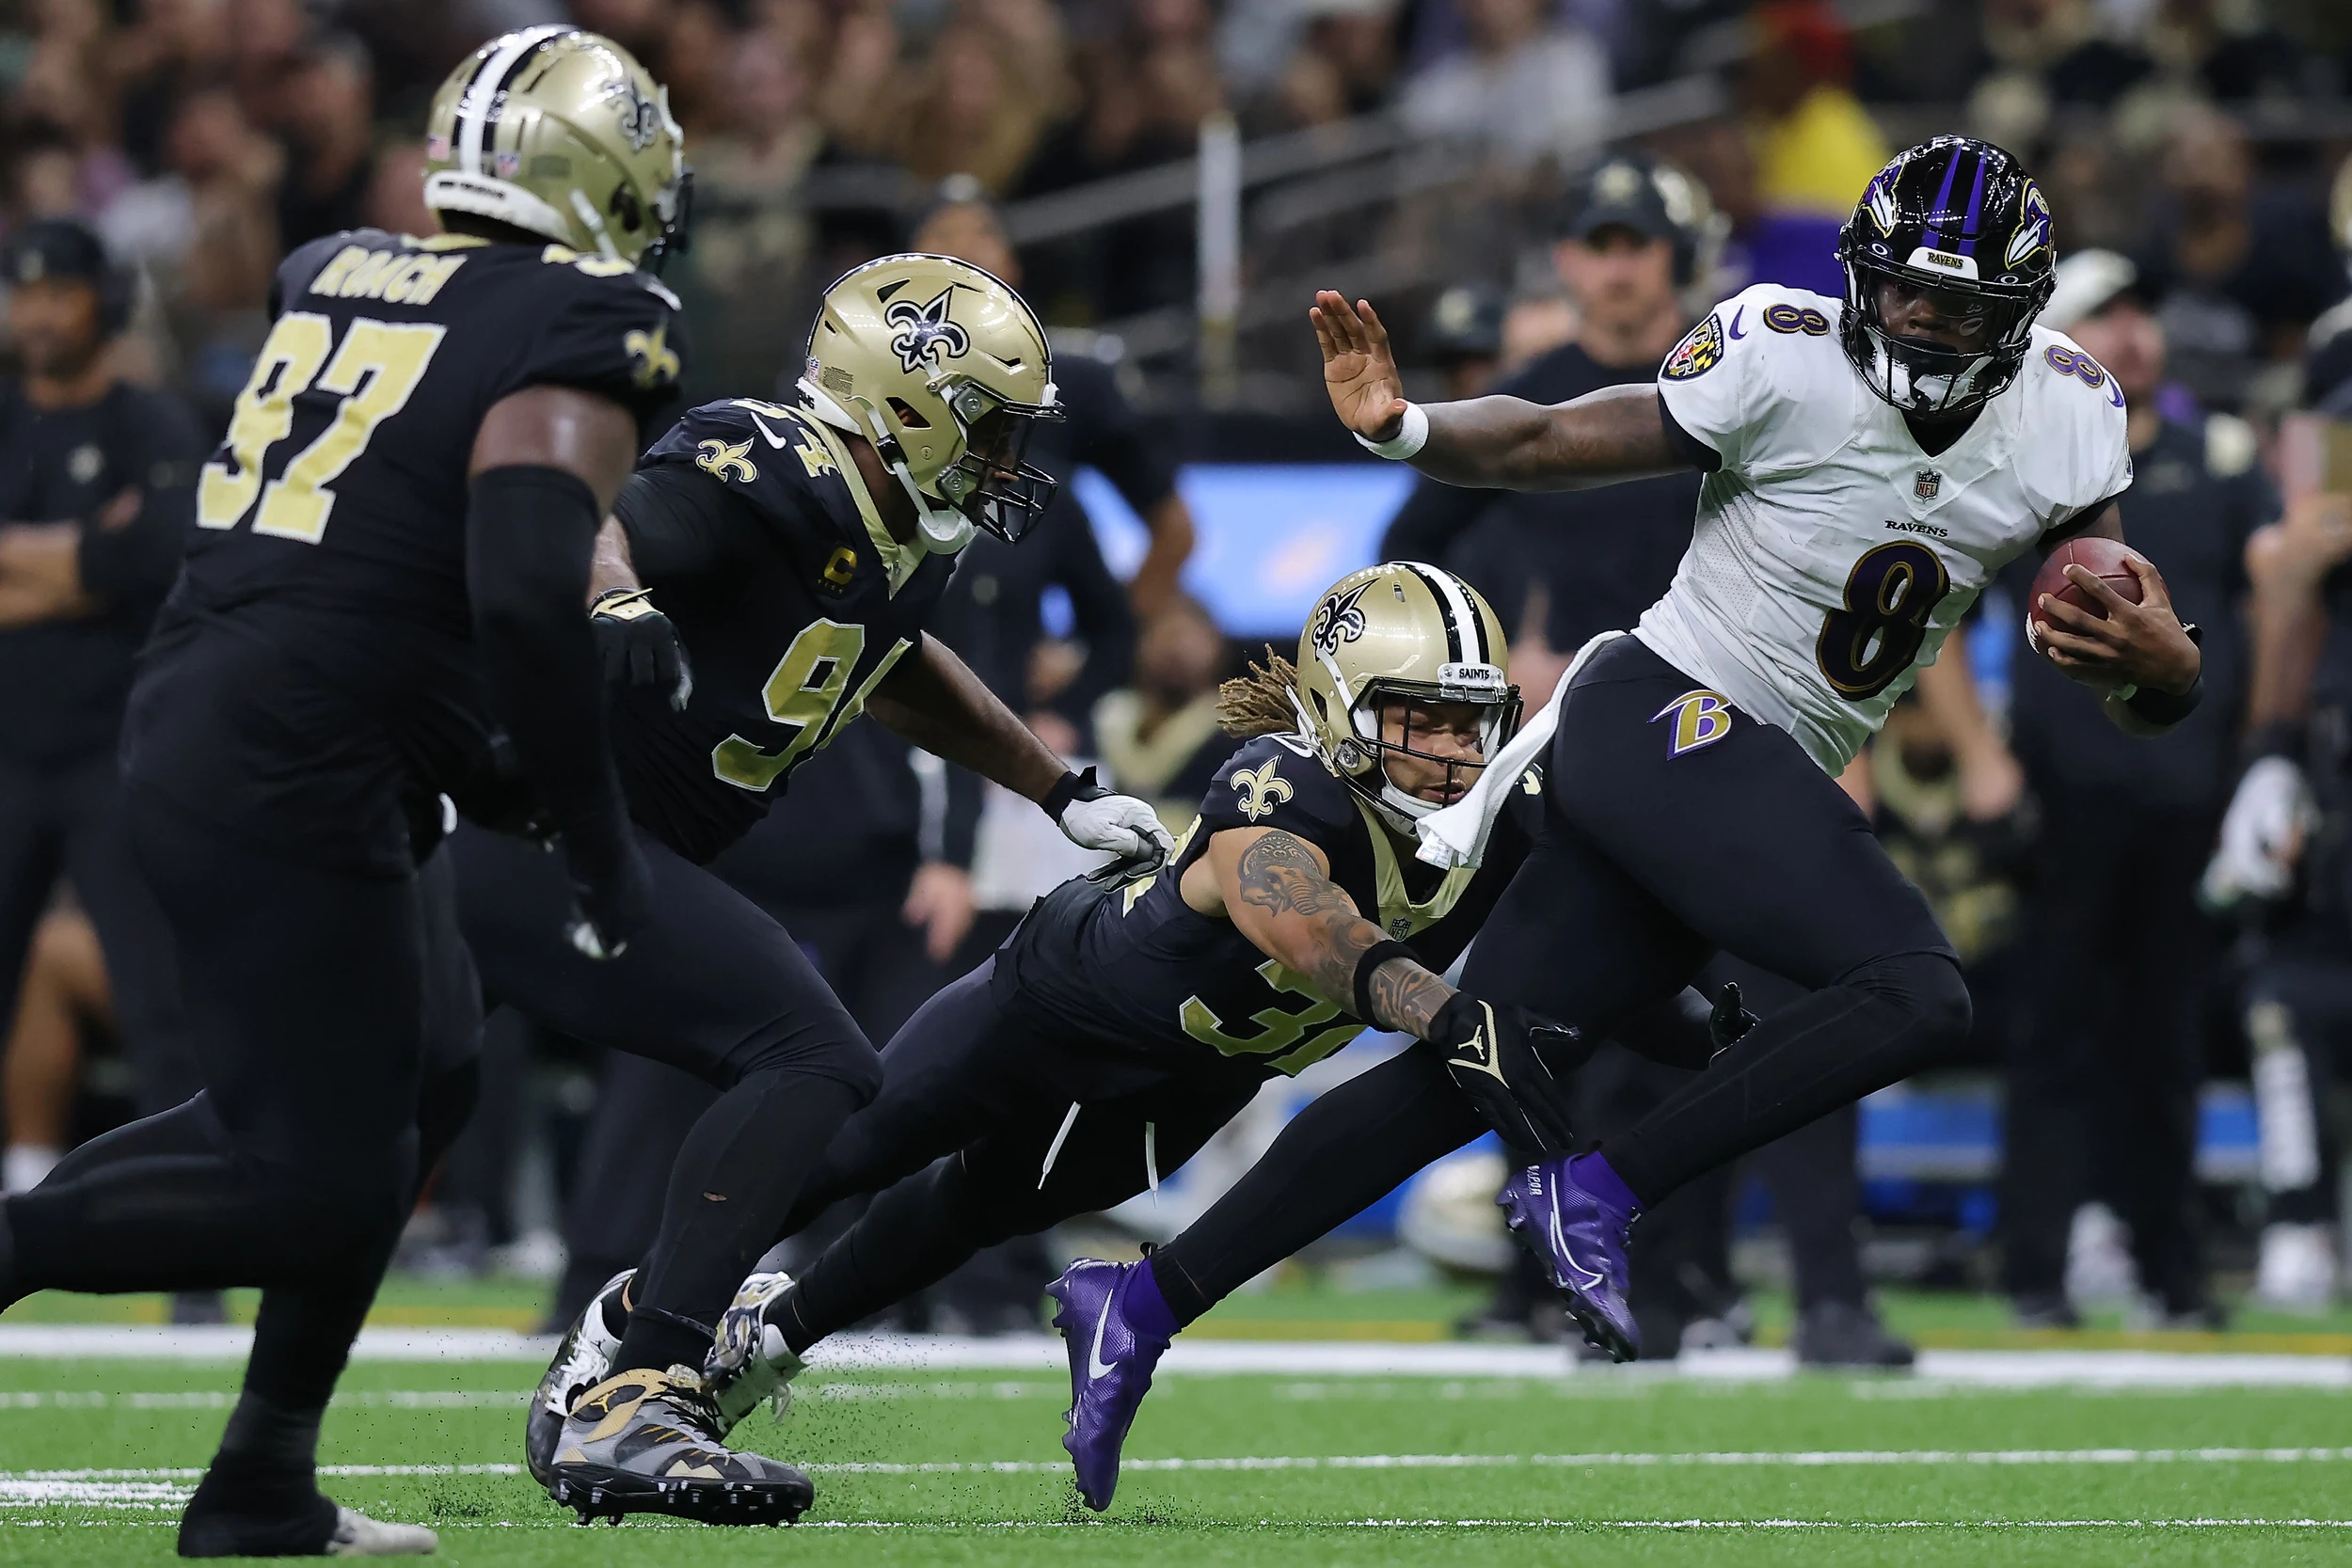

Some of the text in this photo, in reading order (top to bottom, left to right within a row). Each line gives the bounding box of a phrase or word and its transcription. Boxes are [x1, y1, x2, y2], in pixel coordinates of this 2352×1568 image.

[309, 245, 469, 306] ROACH
[1927, 252, 1963, 270] RAVENS
[1709, 315, 1722, 357] RAVENS
[1763, 303, 1831, 337] 8
[2043, 344, 2106, 389] 8
[196, 310, 448, 546] 97
[1917, 482, 1936, 497] NFL
[1884, 520, 1948, 537] RAVENS
[824, 546, 857, 585] C
[1816, 540, 1950, 702] 8
[1458, 668, 1490, 681] SAINTS
[1179, 958, 1370, 1077] 3
[1526, 1164, 1543, 1196] VAPOR
